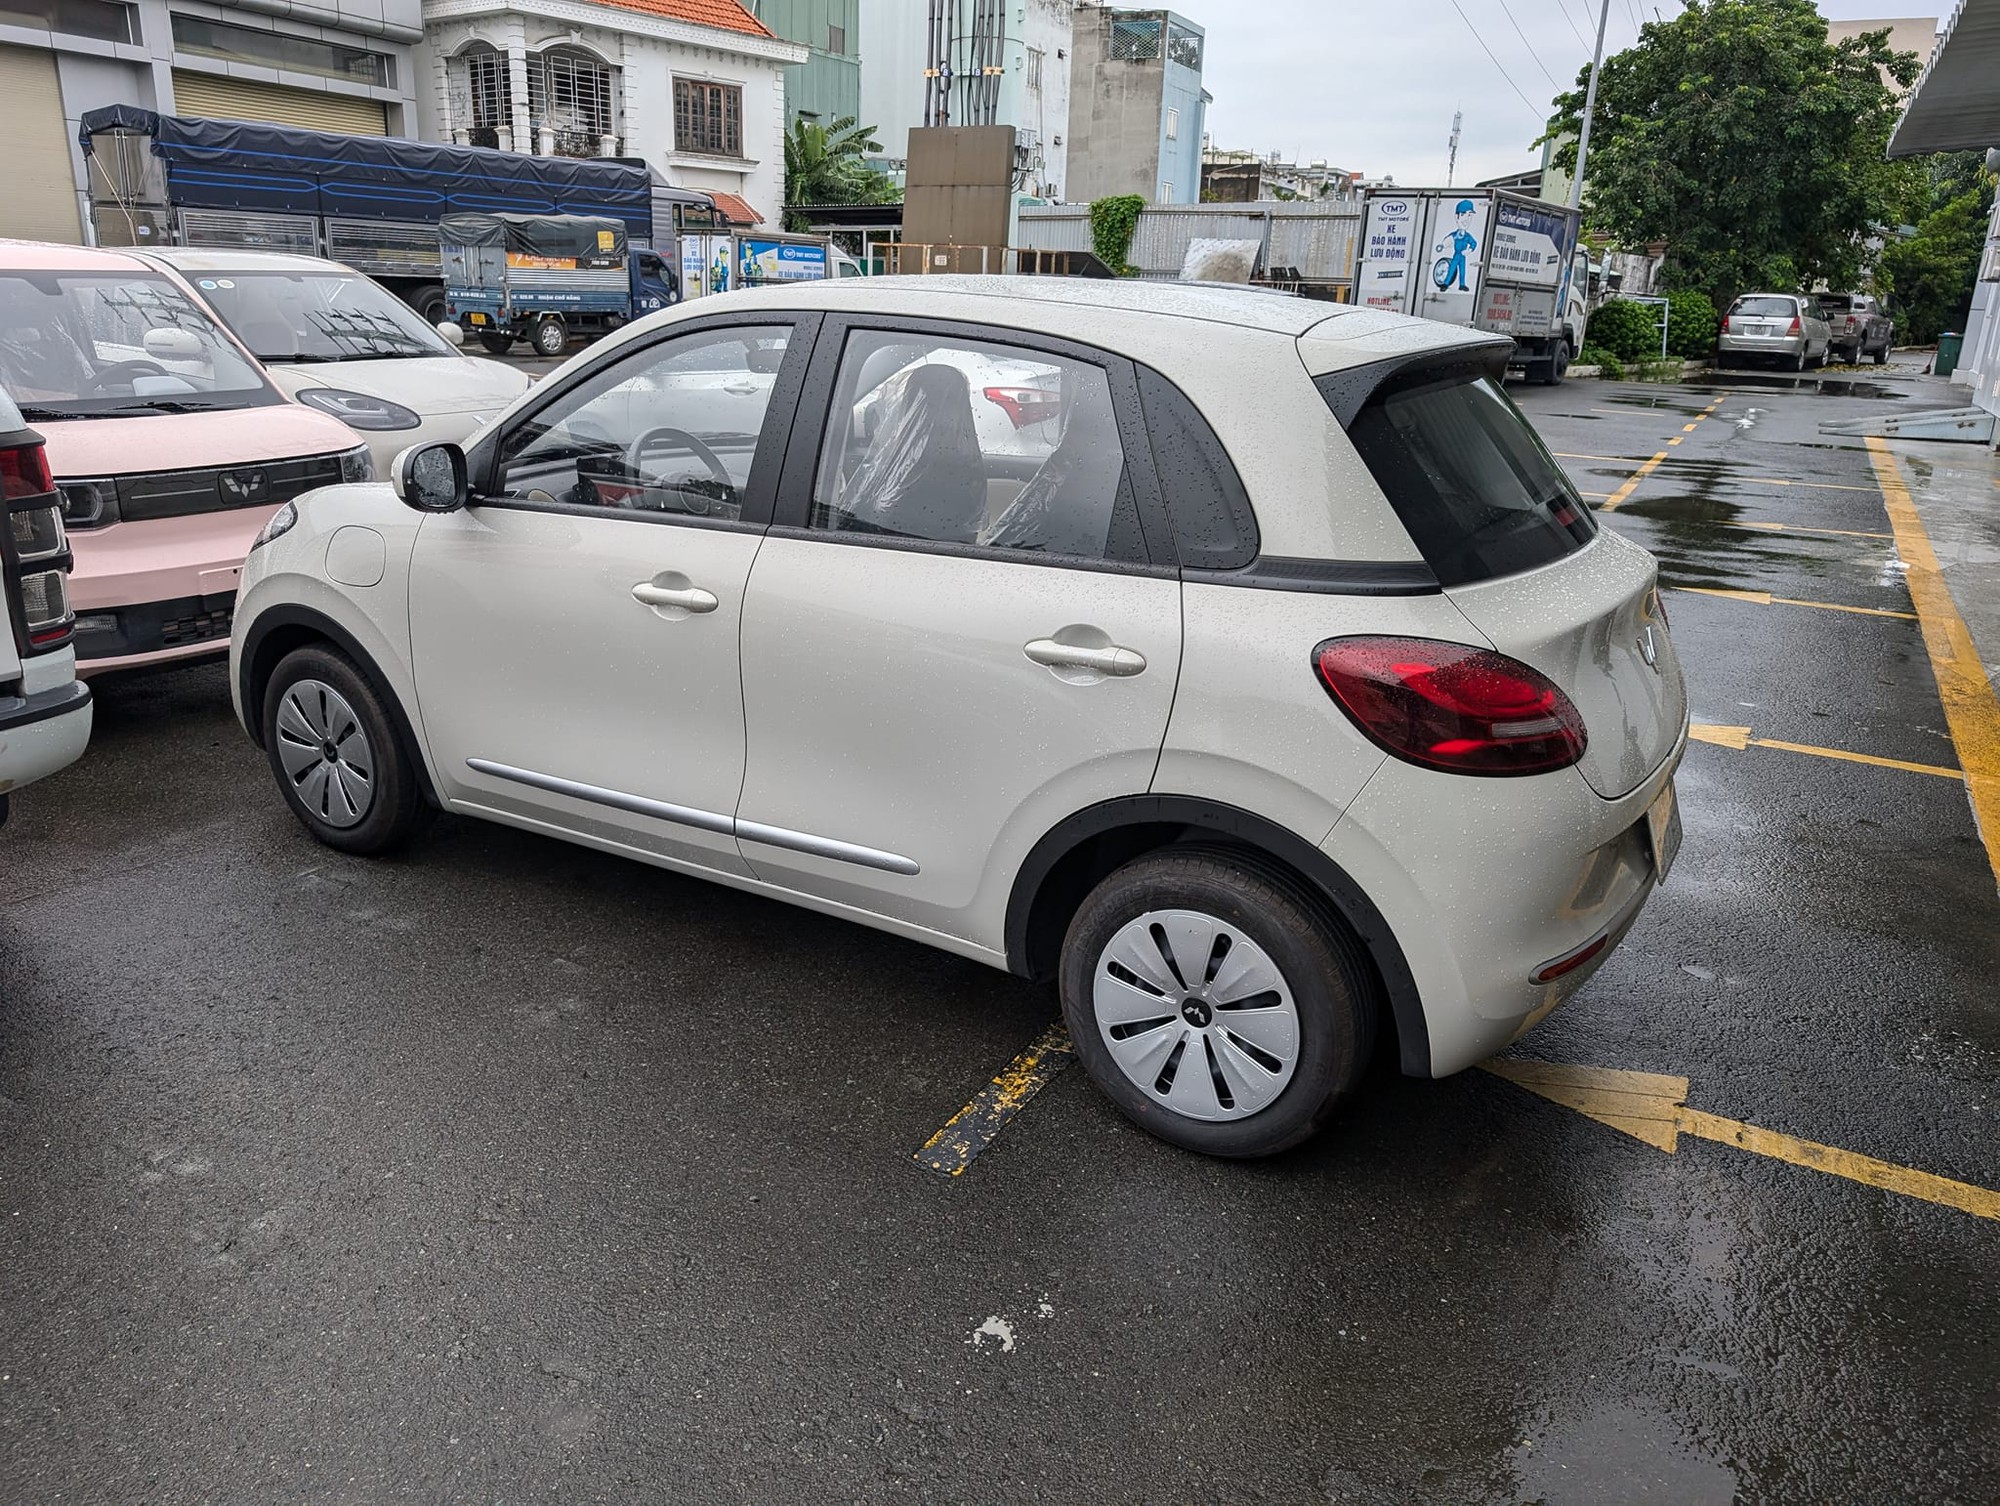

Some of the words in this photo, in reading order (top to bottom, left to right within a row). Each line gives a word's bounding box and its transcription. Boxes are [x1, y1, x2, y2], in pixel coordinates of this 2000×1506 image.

[1387, 224, 1396, 233] XE
[1372, 234, 1386, 246] BẢO
[1387, 235, 1406, 246] HÀNH
[1370, 248, 1384, 258] LƯU
[1386, 248, 1405, 260] ĐỘNG
[1367, 296, 1392, 306] HOTLINE:
